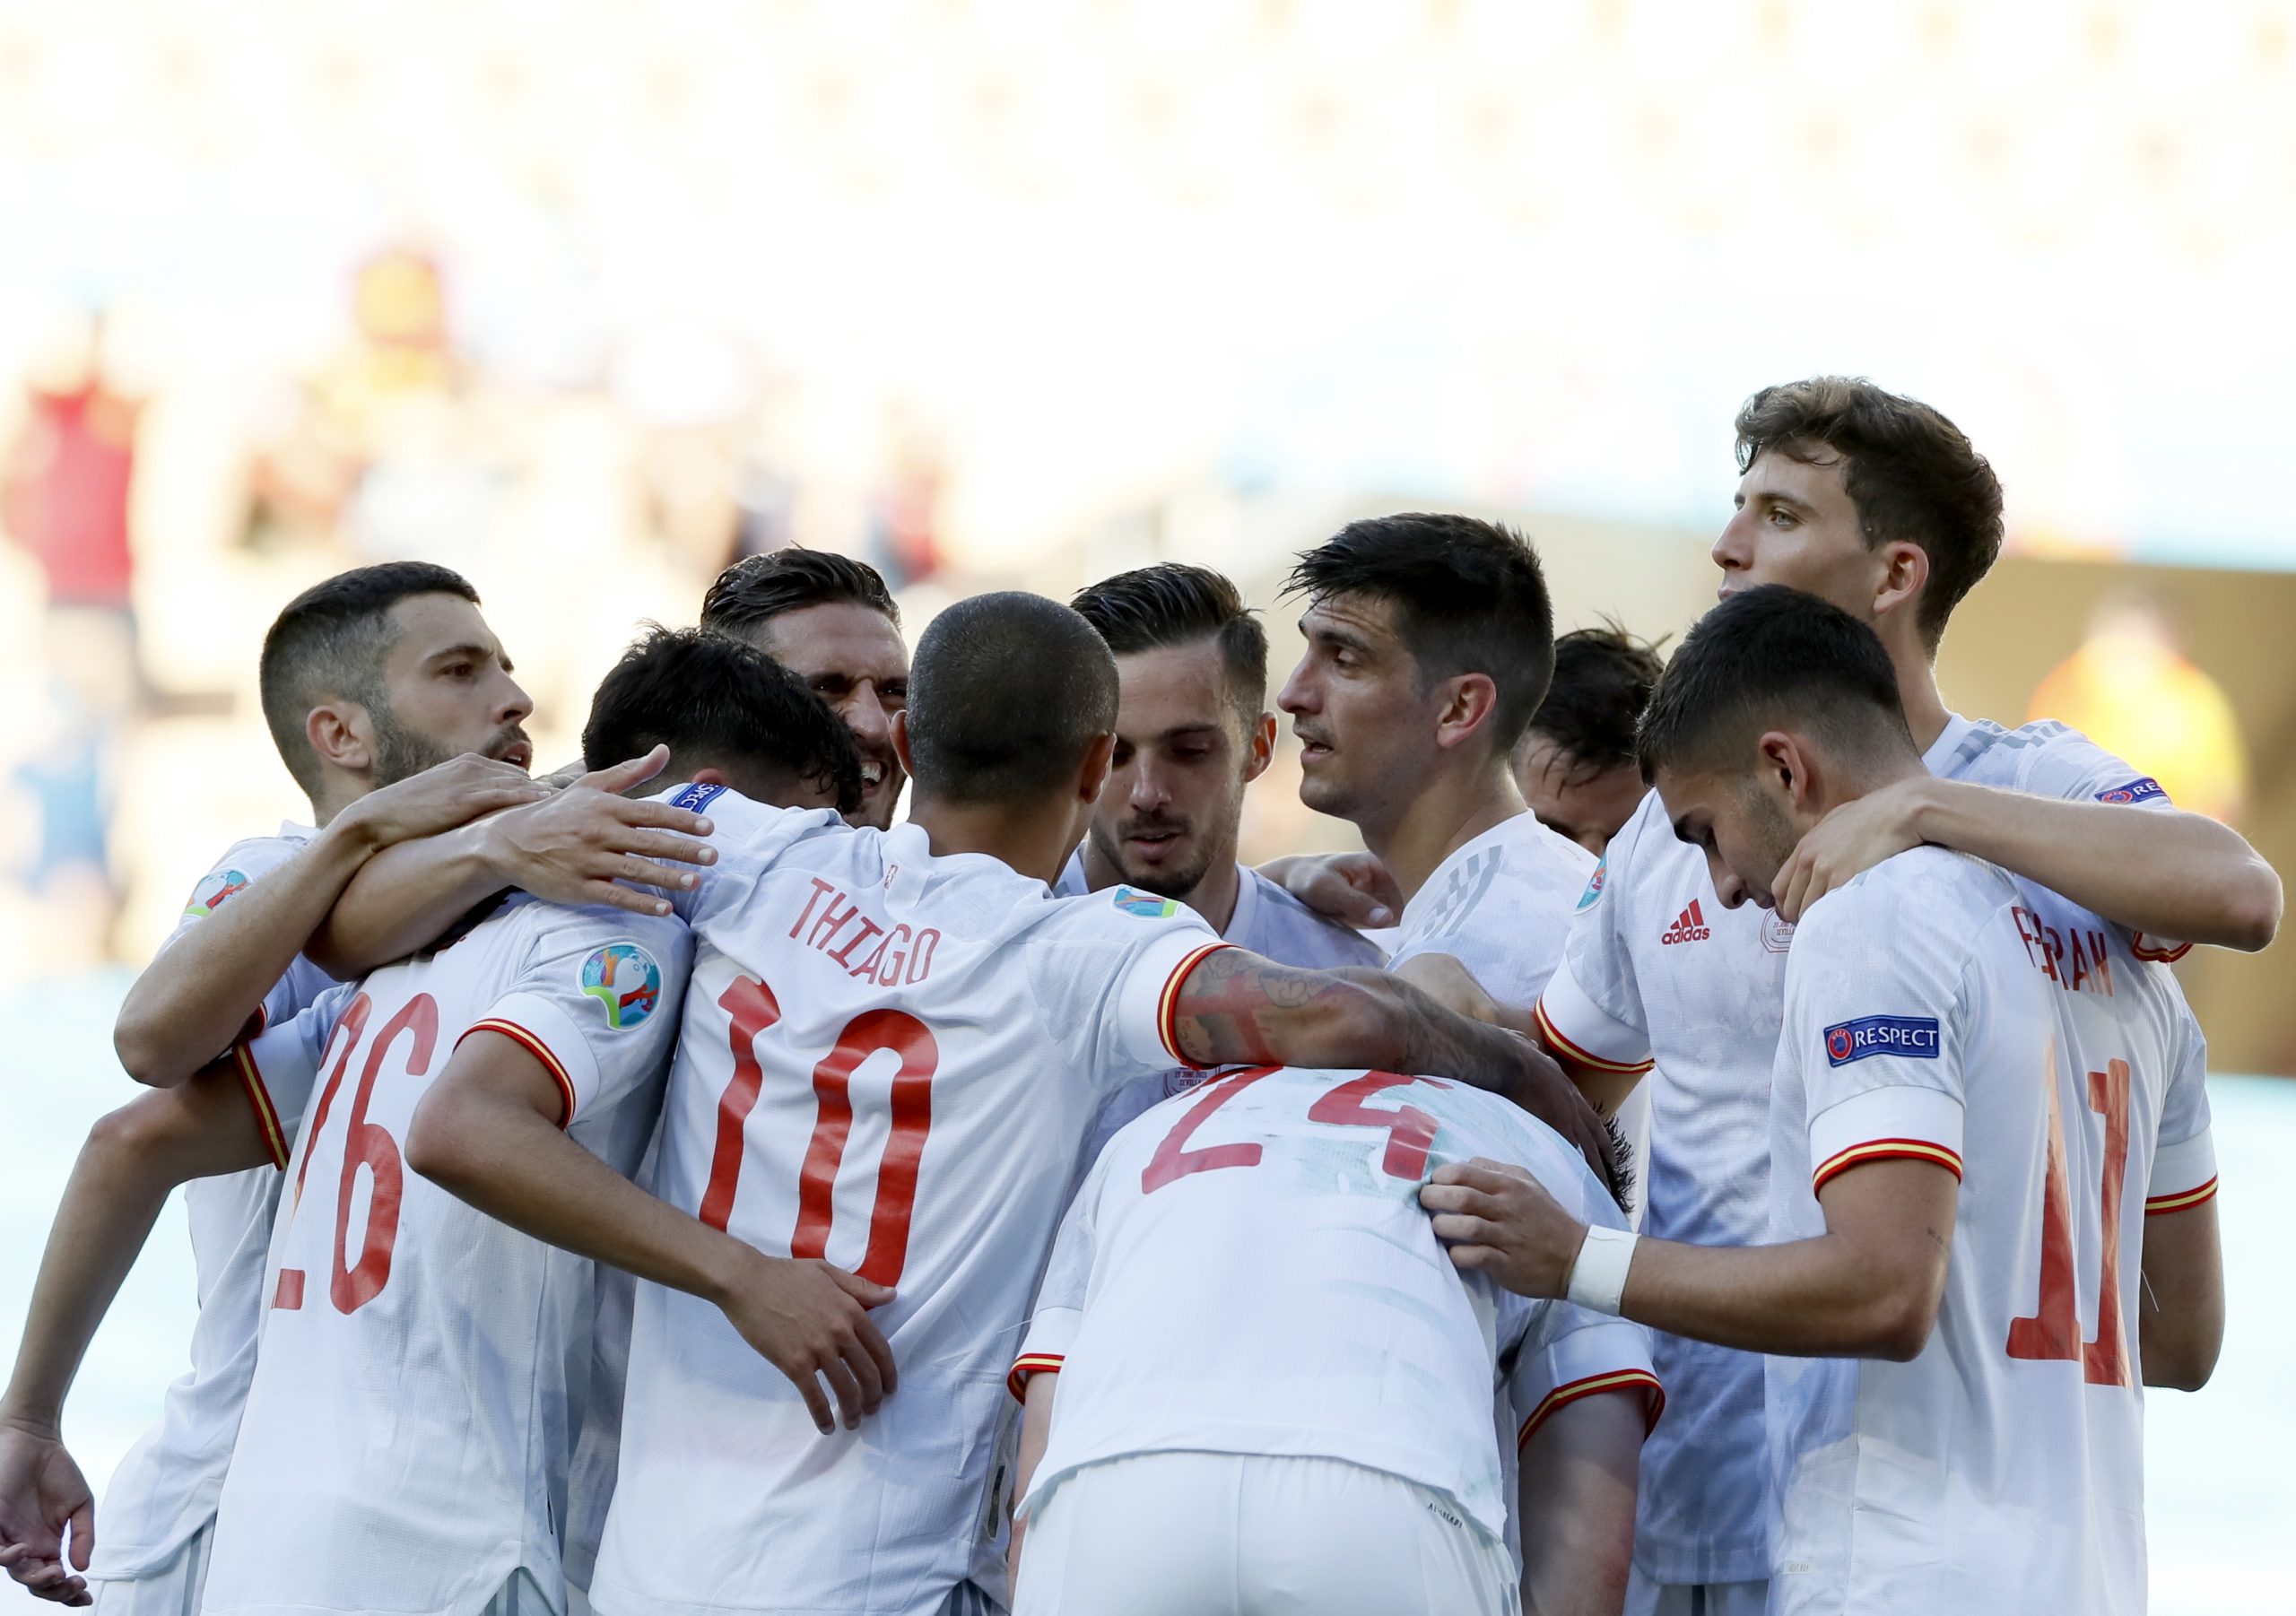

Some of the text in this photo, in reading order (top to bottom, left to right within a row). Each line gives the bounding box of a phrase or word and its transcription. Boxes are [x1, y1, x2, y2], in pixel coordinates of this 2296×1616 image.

[789, 877, 941, 986] THIAGO
[1662, 925, 1710, 944] adidas
[1855, 1027, 1937, 1048] RESPECT
[271, 992, 439, 1315] 26
[700, 975, 939, 1311] 10
[2006, 1034, 2134, 1388] 11
